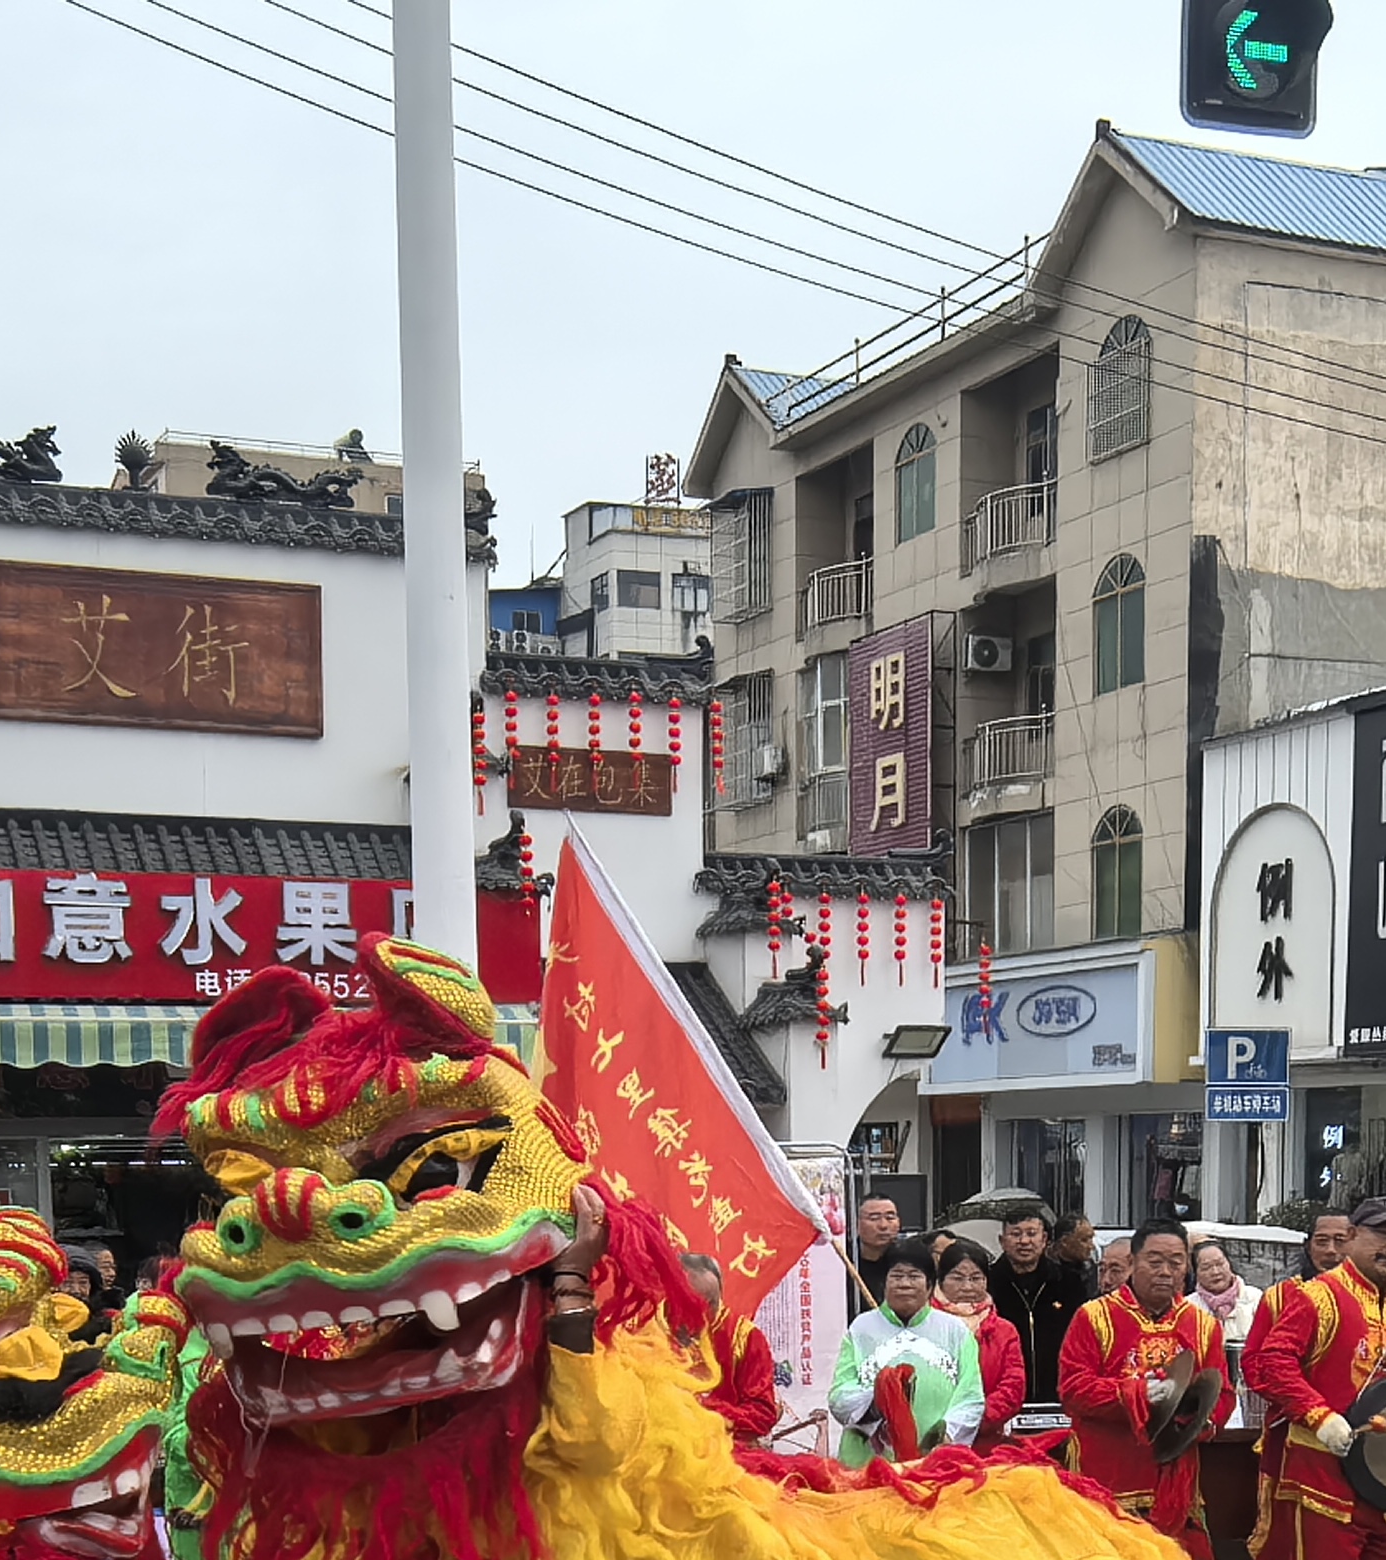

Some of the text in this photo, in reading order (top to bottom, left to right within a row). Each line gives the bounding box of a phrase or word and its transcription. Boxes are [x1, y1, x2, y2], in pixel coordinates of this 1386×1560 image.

[60, 593, 251, 707] 艾街
[520, 753, 664, 808] 艾在包集
[869, 650, 907, 833] 明月
[1227, 1036, 1257, 1080] P
